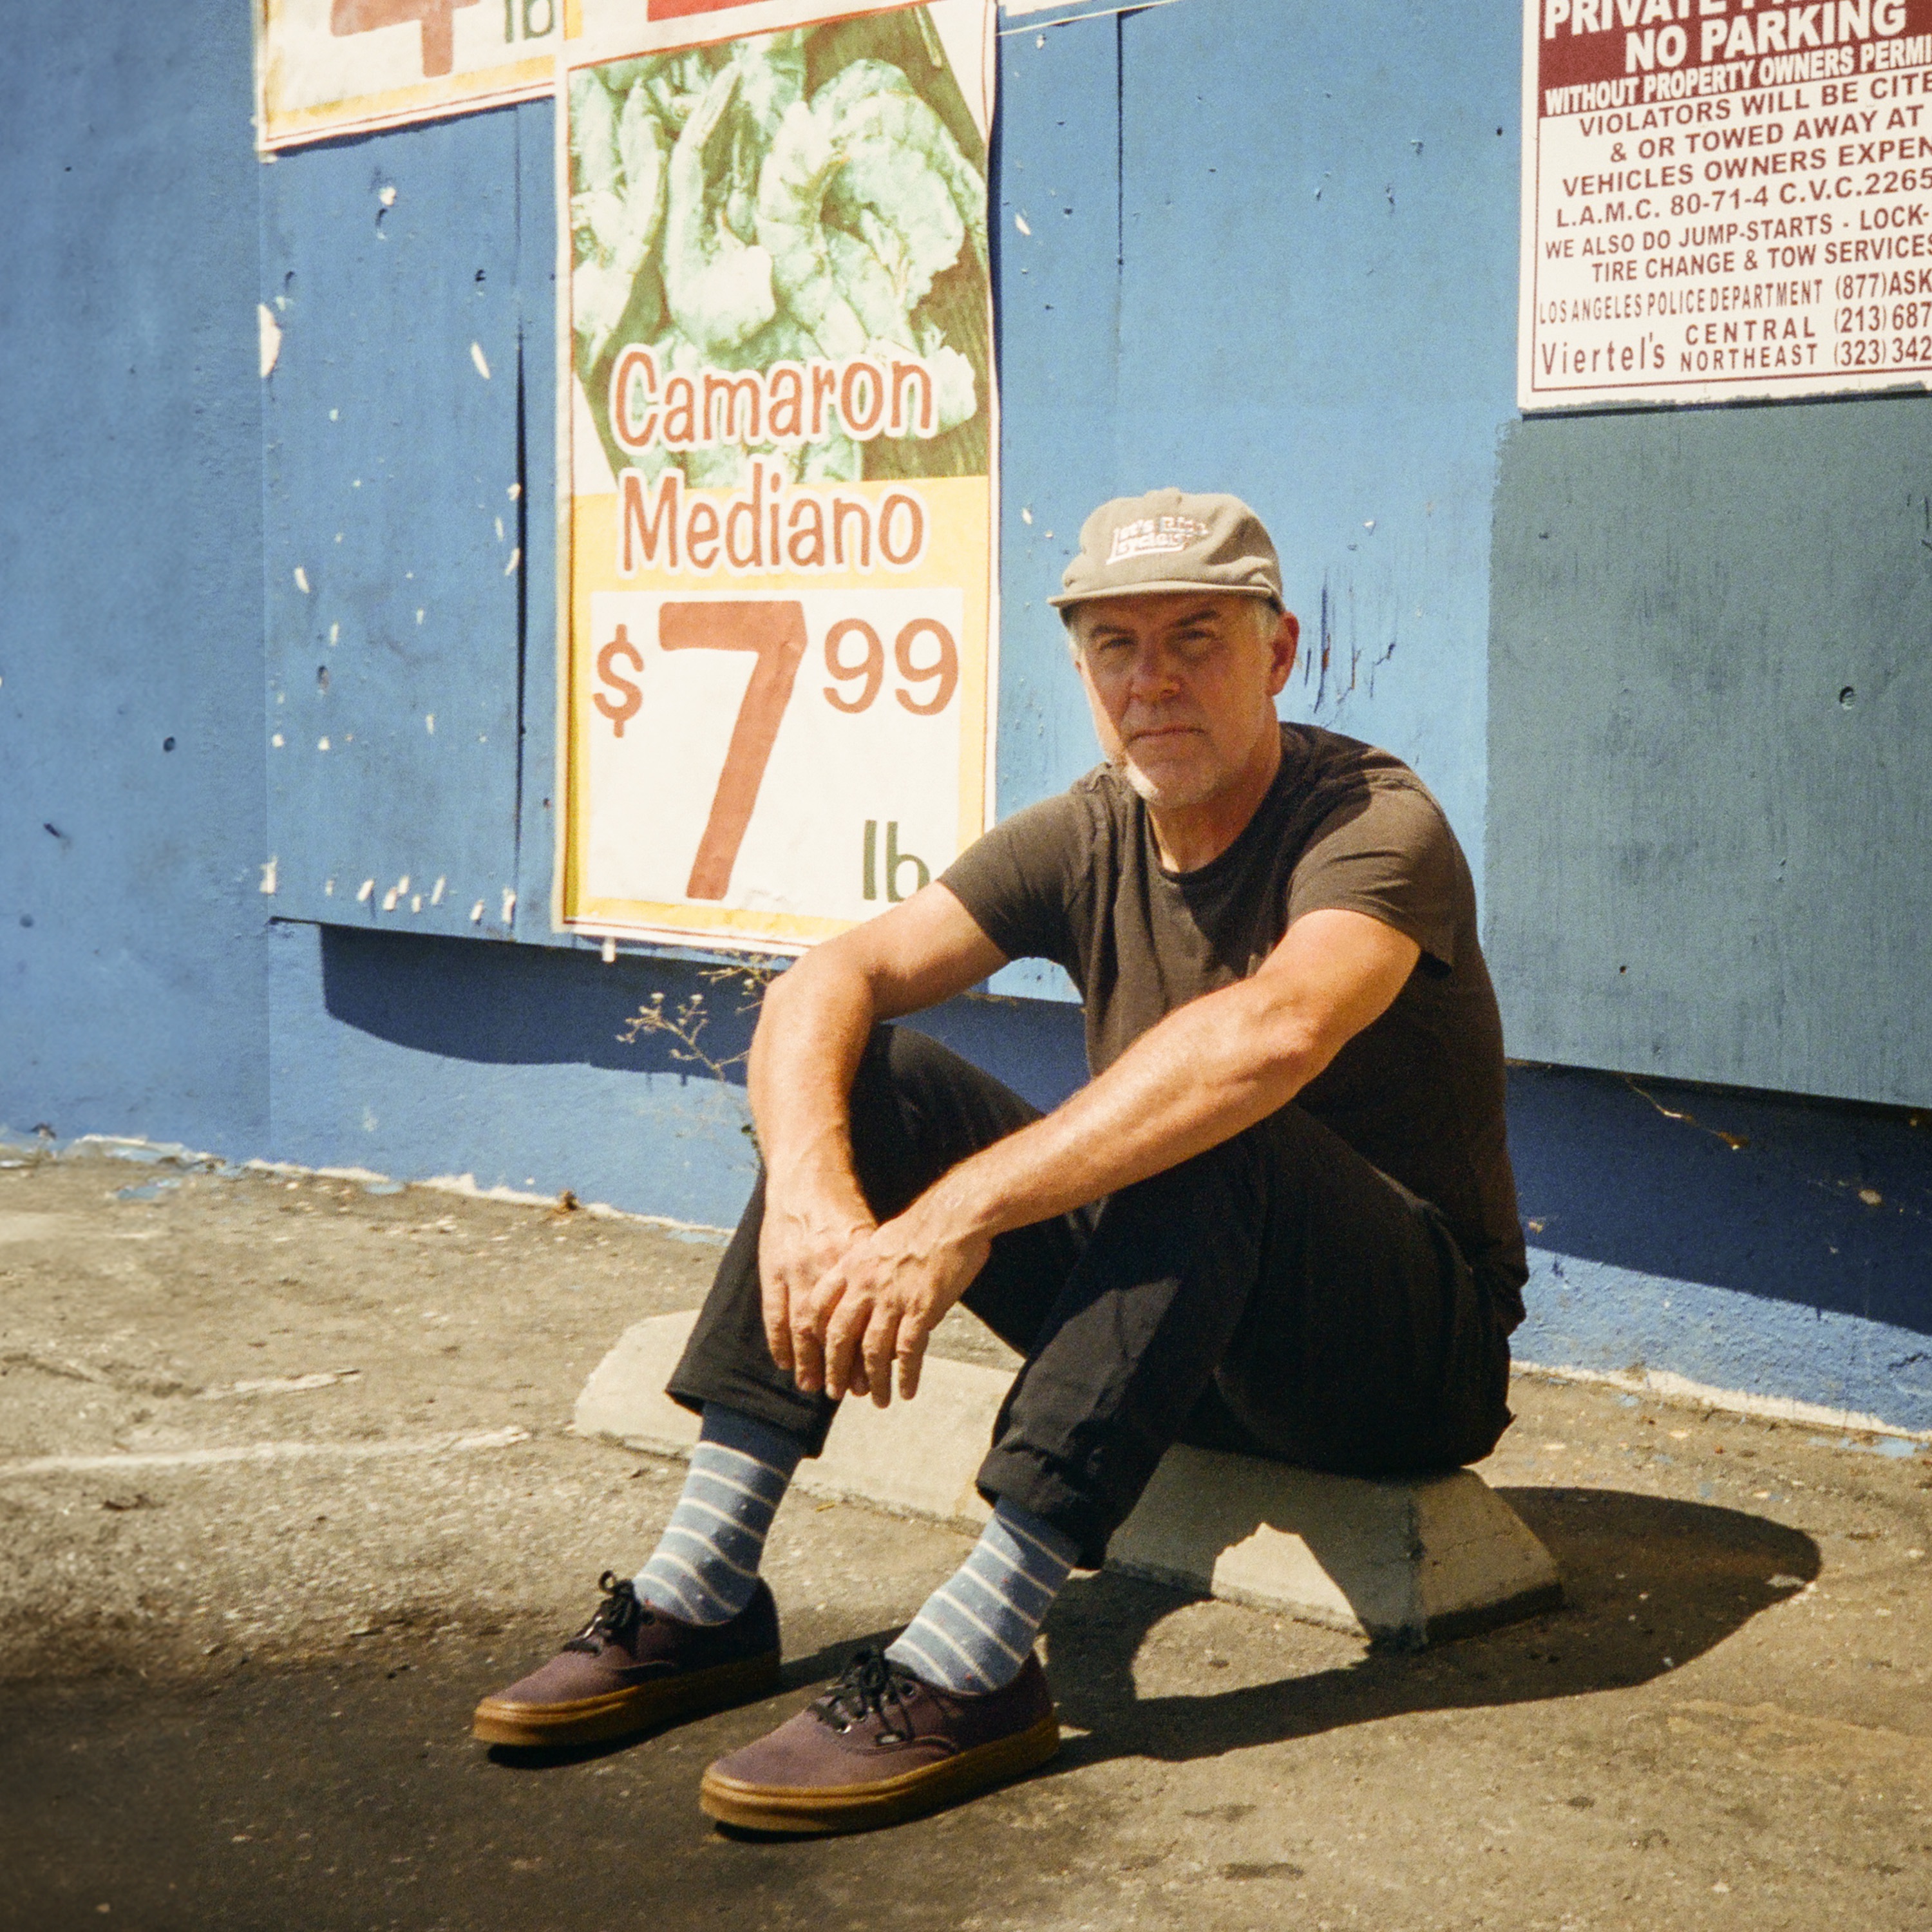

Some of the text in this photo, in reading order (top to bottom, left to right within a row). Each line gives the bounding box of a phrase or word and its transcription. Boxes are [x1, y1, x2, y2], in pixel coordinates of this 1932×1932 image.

[1625, 0, 1906, 73] NO PARKING
[1546, 77, 1640, 117] WITHOUT
[1643, 60, 1756, 103] PROPERTY
[1759, 46, 1854, 86] OWNERS
[1579, 99, 1730, 137] VIOLATORS
[1741, 89, 1810, 117] WILL
[1821, 81, 1858, 106] BE
[1611, 104, 1924, 162] & OR TOWED AWAY AT
[1563, 136, 1932, 197] VEHICLES OWNERS EXPEN
[1546, 240, 1573, 259] WE
[1582, 234, 1634, 256] ALSO
[1643, 230, 1671, 251] DO
[1679, 213, 1832, 247] JUMP-STARTS
[1861, 204, 1929, 231] LOCK-
[1557, 198, 1660, 227] L.A.M.C.
[1671, 185, 1768, 216] 80-71-4
[1592, 260, 1637, 282] TIRE
[1645, 251, 1734, 279] CHANGE
[1744, 249, 1758, 271] &
[1767, 244, 1816, 269] TOW
[1540, 299, 1566, 324] LOS
[1571, 294, 1642, 321] ANGELES
[1648, 289, 1704, 316] POLICE
[1710, 279, 1823, 311] DEPARTMENT
[1542, 332, 1665, 375] Viertel's
[1681, 343, 1818, 372] NORTHEAST
[1685, 316, 1815, 345] CENTRAL
[615, 351, 933, 448] Camaron
[621, 462, 925, 573] Mediano
[862, 819, 931, 904] lb
